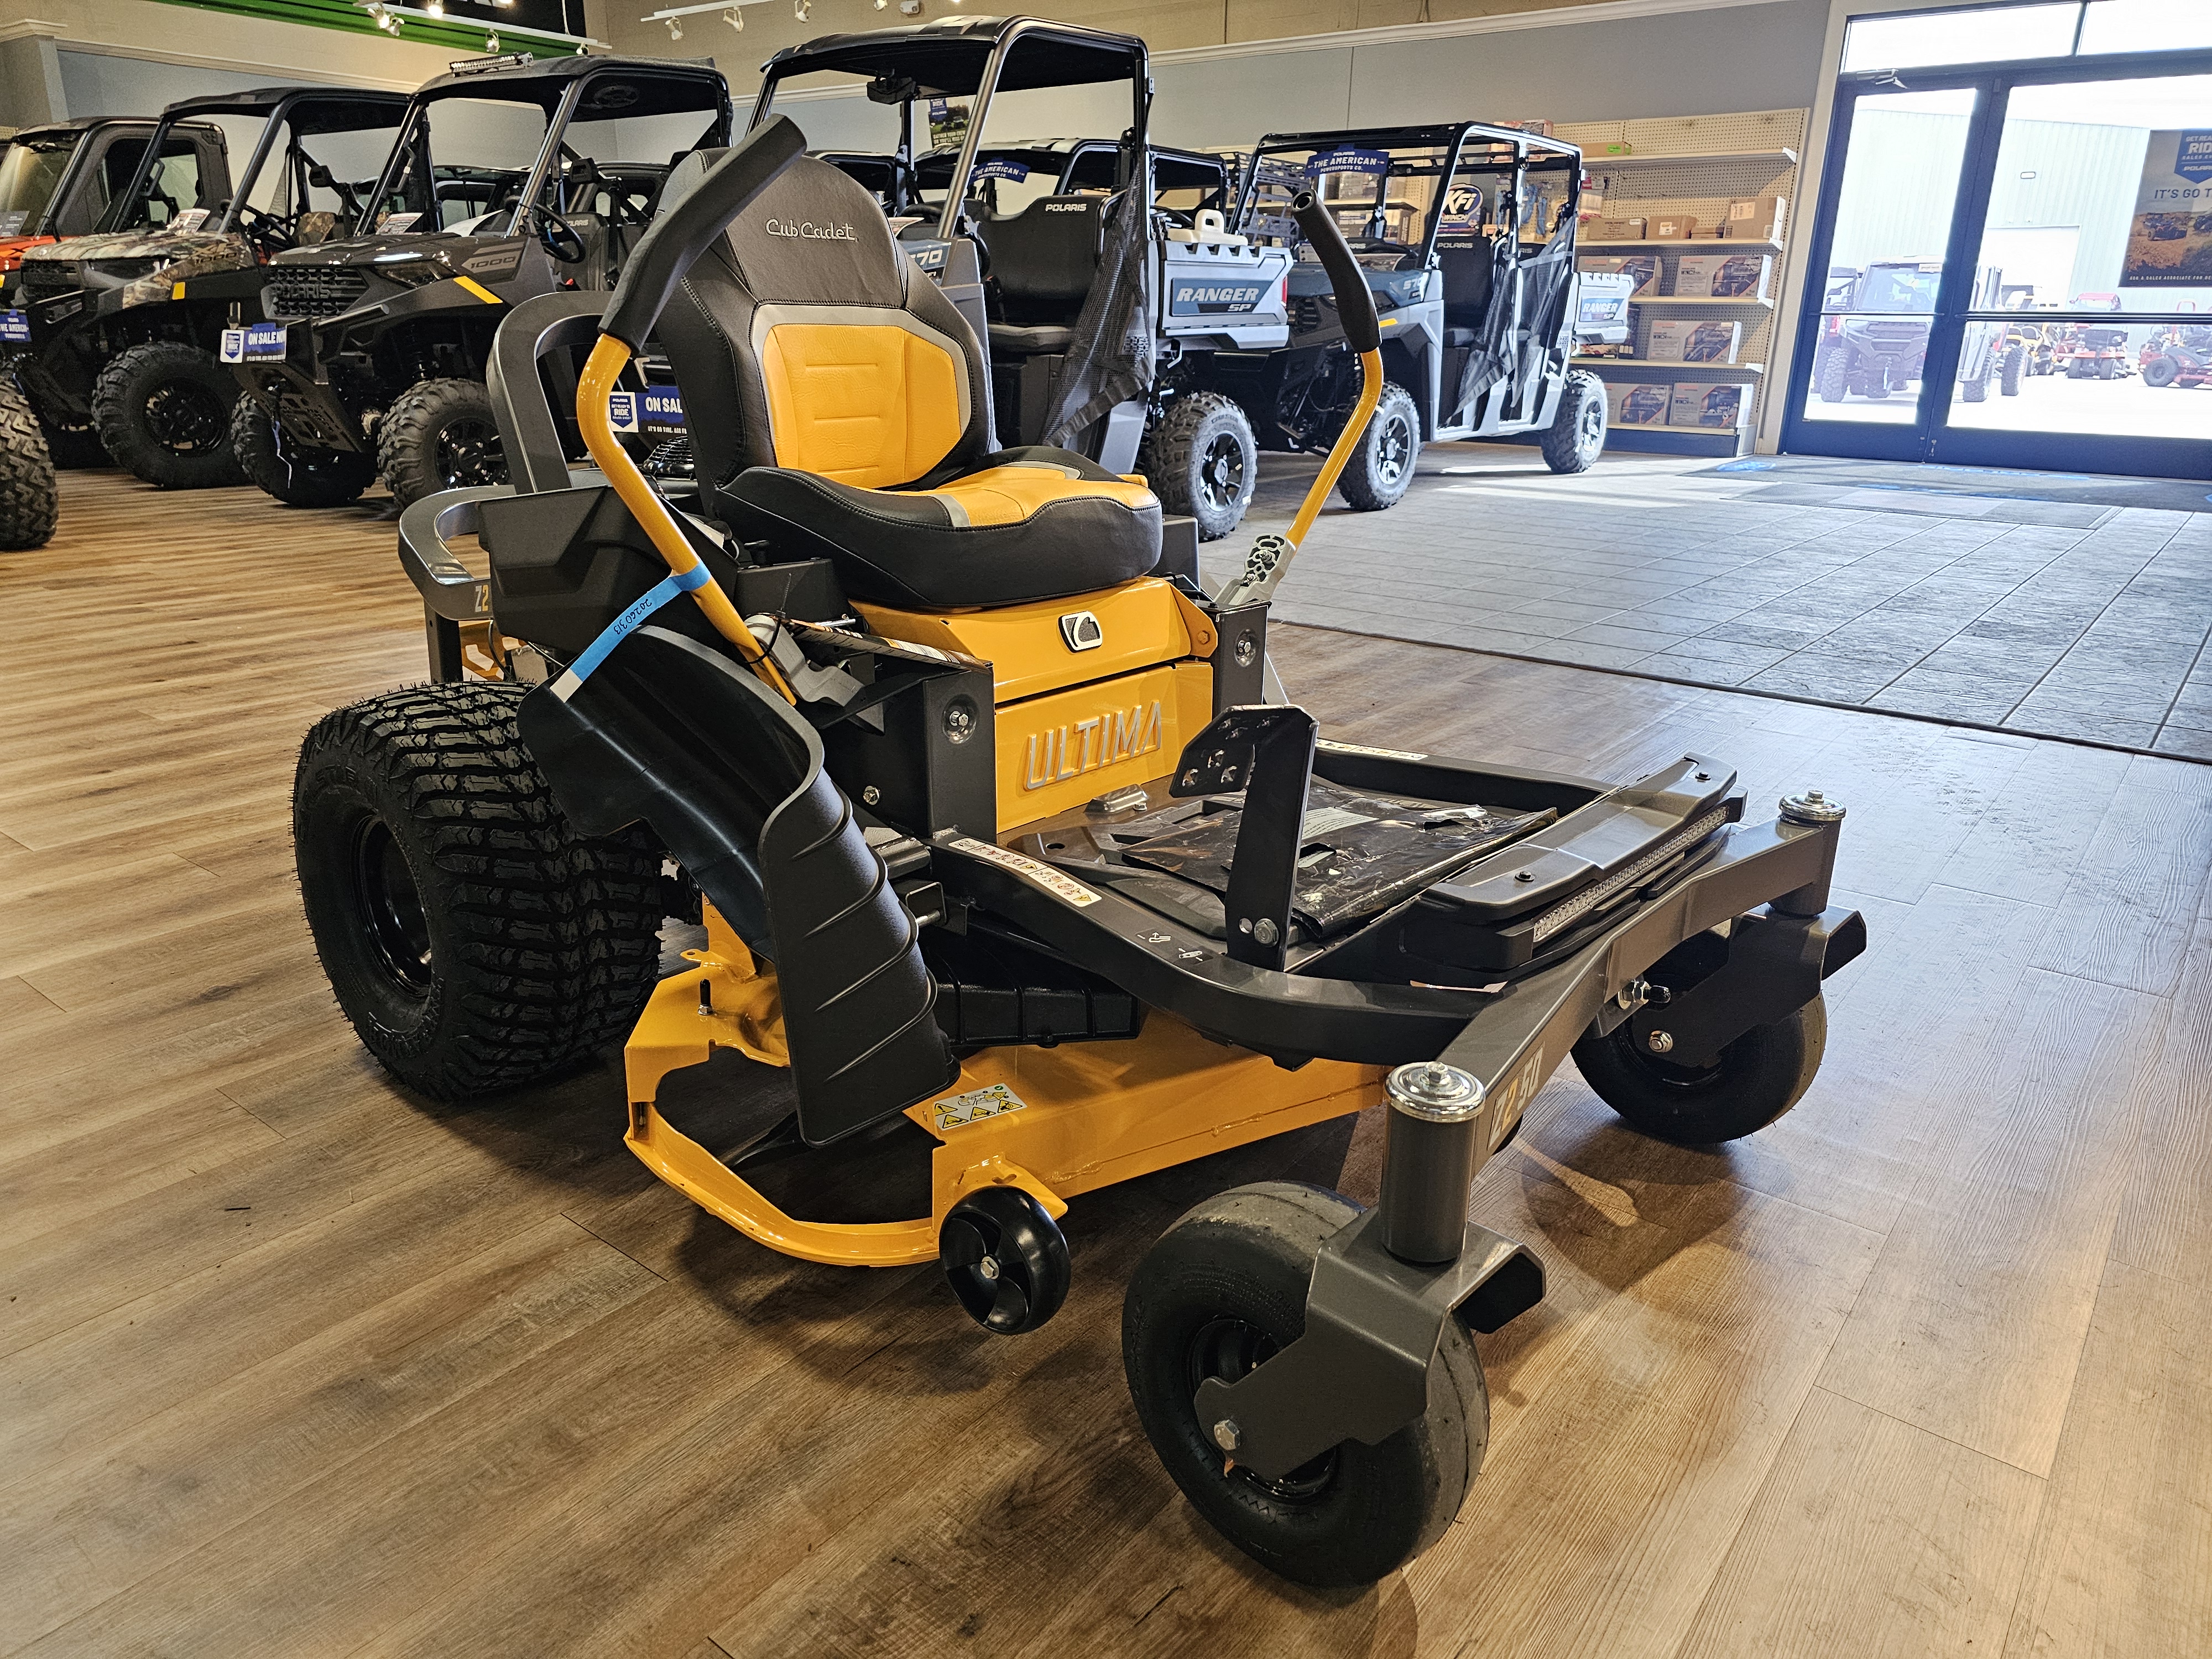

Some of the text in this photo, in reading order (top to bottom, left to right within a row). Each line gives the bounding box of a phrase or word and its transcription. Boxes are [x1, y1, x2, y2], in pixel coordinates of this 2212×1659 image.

[2188, 143, 2212, 154] RID
[1314, 157, 1377, 168] THE AMERICAN
[975, 166, 1019, 177] THE AMERICAN
[2154, 189, 2179, 199] IT'S
[2182, 188, 2201, 199] GO
[1045, 204, 1087, 212] POLARIS
[765, 218, 856, 241] Cub Cadet
[471, 256, 516, 269] 1000
[1176, 288, 1260, 302] RANGER
[1227, 304, 1252, 312] SP
[1582, 302, 1619, 313] RANGER
[248, 332, 258, 346] ON
[258, 331, 276, 345] SALE
[645, 397, 683, 414] ON SAL
[614, 408, 629, 416] RIDE
[1024, 700, 1161, 792] ULTIMA
[1488, 1077, 1519, 1147] Z2
